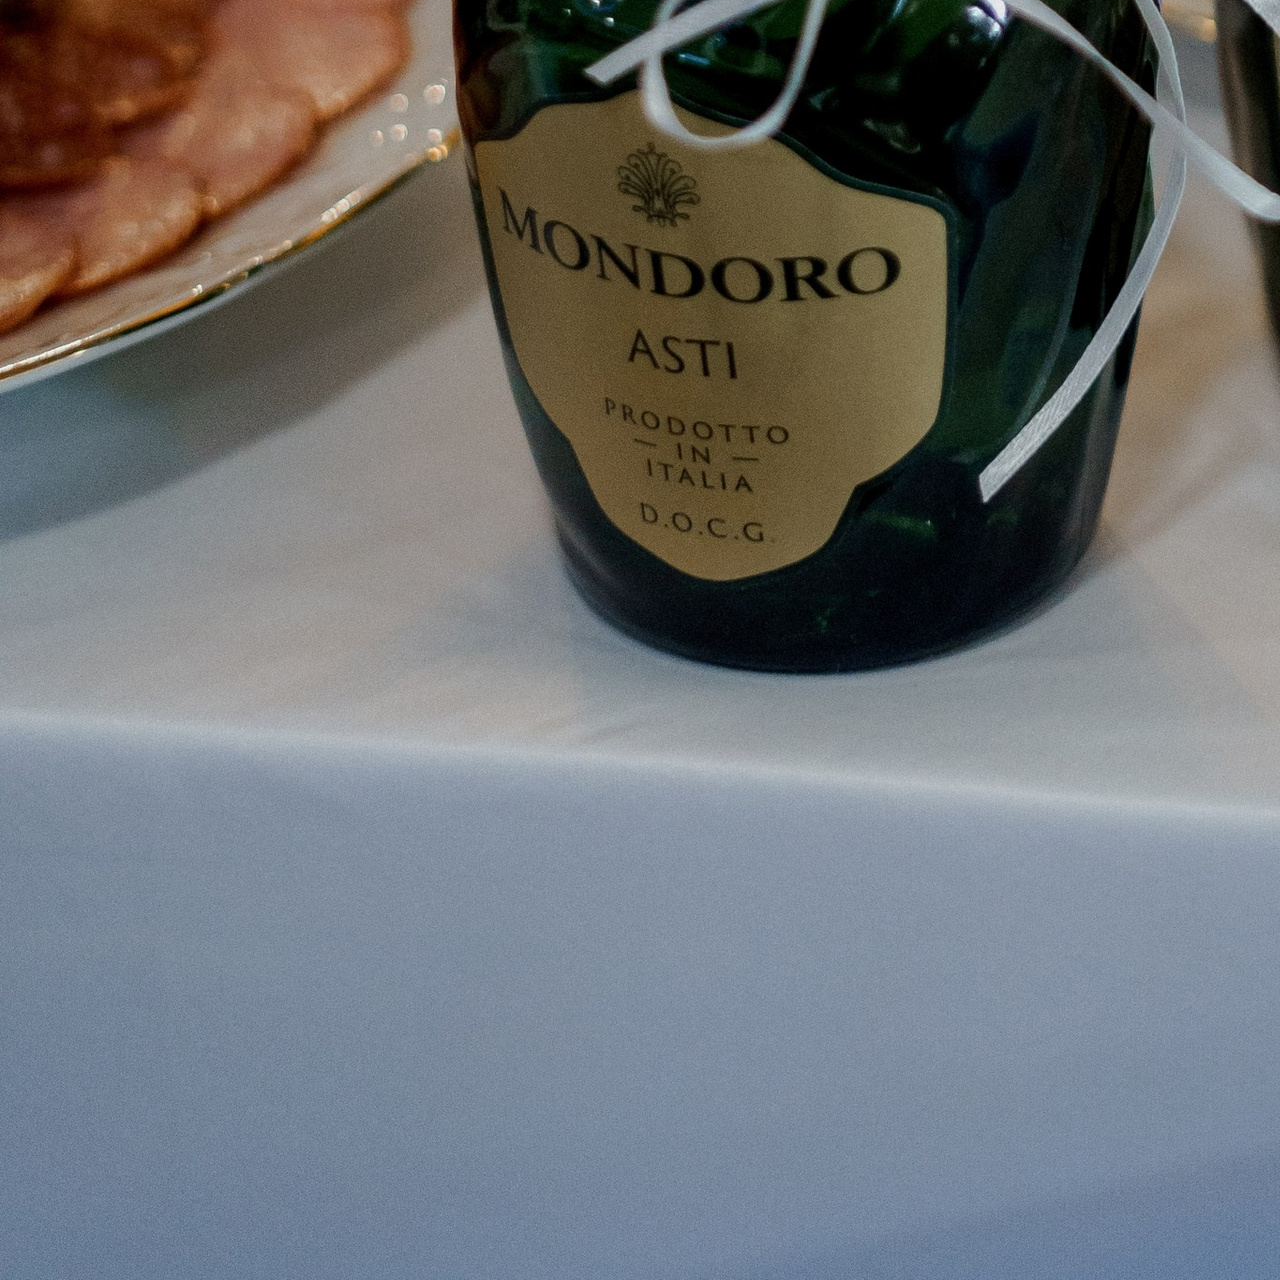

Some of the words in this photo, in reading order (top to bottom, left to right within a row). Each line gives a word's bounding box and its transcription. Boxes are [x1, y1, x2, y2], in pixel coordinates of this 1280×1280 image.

[497, 184, 902, 304] MONDORO
[627, 329, 739, 380] ASTI
[604, 397, 791, 445] PRODOTTO
[646, 458, 754, 493] ITALIA
[677, 443, 712, 464] IN
[639, 502, 776, 544] D.O.C.G.
